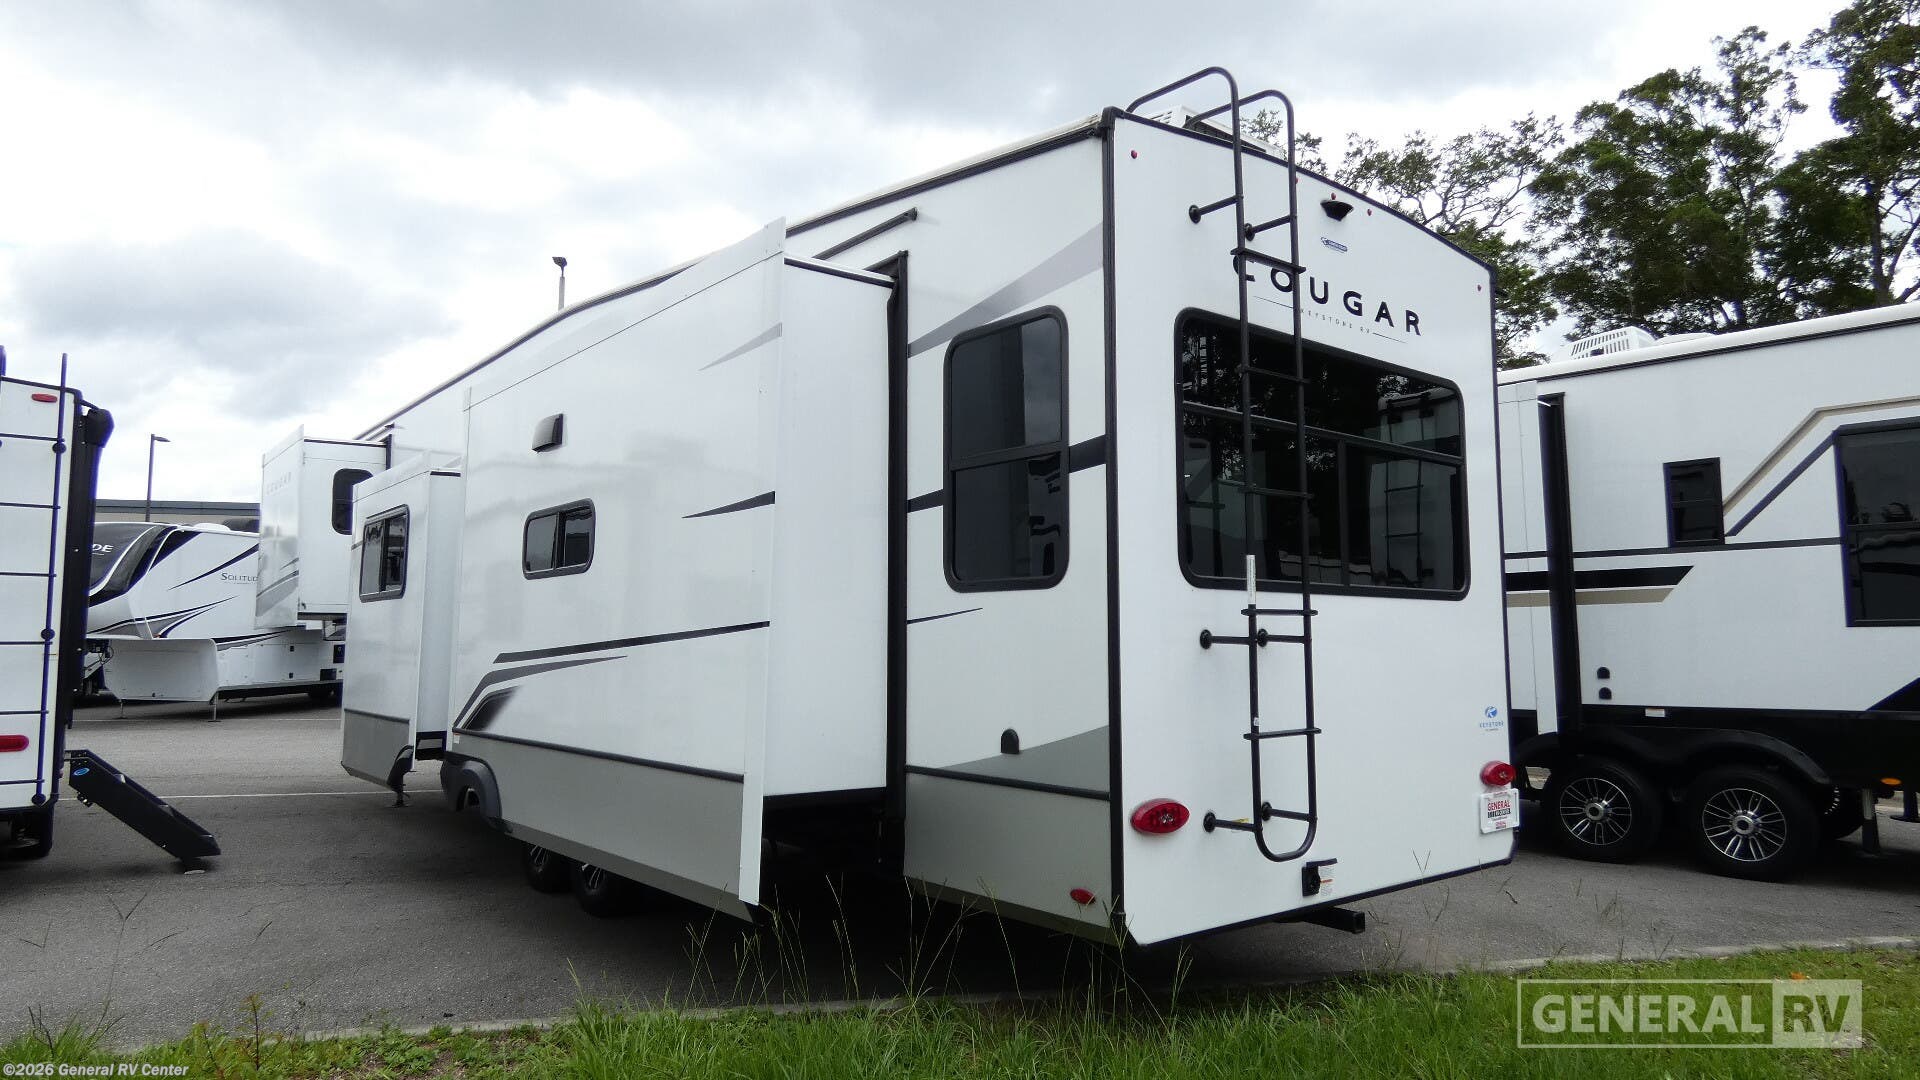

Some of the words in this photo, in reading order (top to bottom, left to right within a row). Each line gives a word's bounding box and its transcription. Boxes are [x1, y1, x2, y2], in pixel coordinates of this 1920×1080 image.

[1232, 253, 1422, 337] COUGAR
[1301, 307, 1353, 329] KEYSTONE
[1487, 799, 1511, 812] GENERAL
